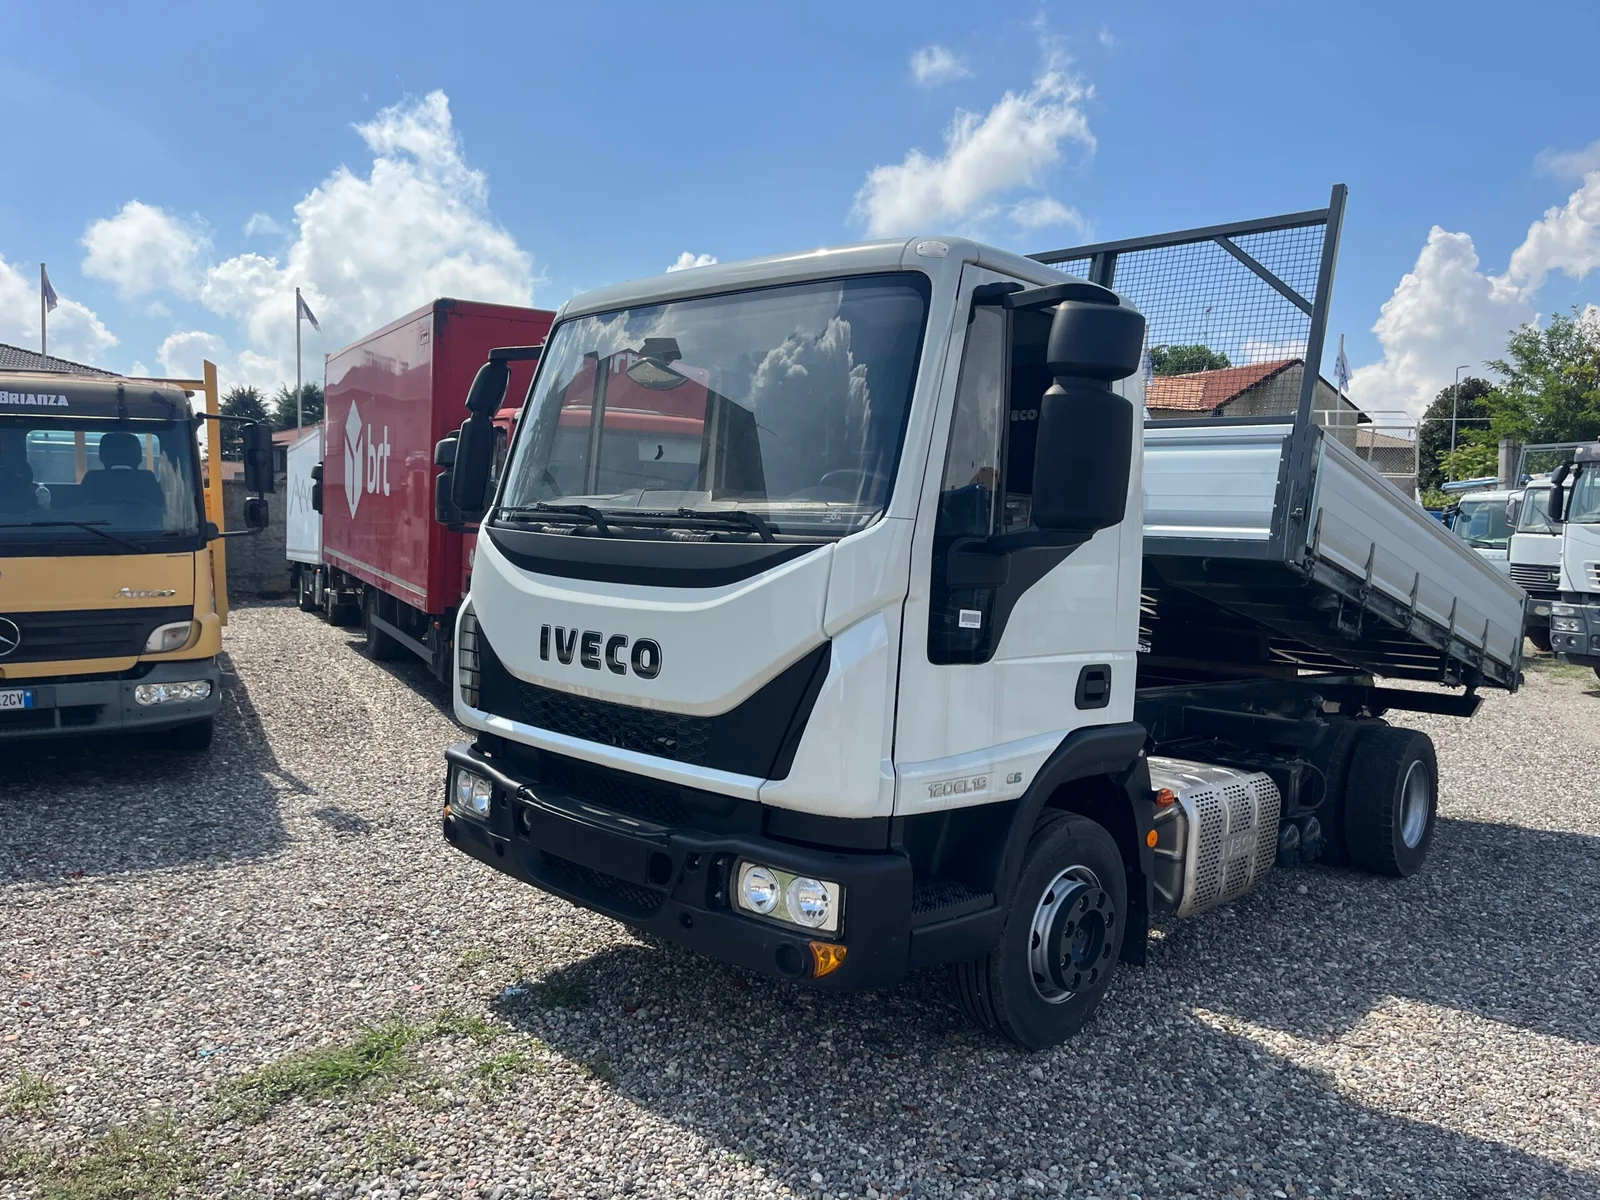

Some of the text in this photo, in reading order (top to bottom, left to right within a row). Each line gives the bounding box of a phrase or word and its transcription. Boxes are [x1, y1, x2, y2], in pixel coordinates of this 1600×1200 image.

[0, 390, 69, 406] BRIANZA
[366, 423, 391, 497] brt
[539, 623, 663, 680] IVECO
[0, 693, 23, 707] 2GV
